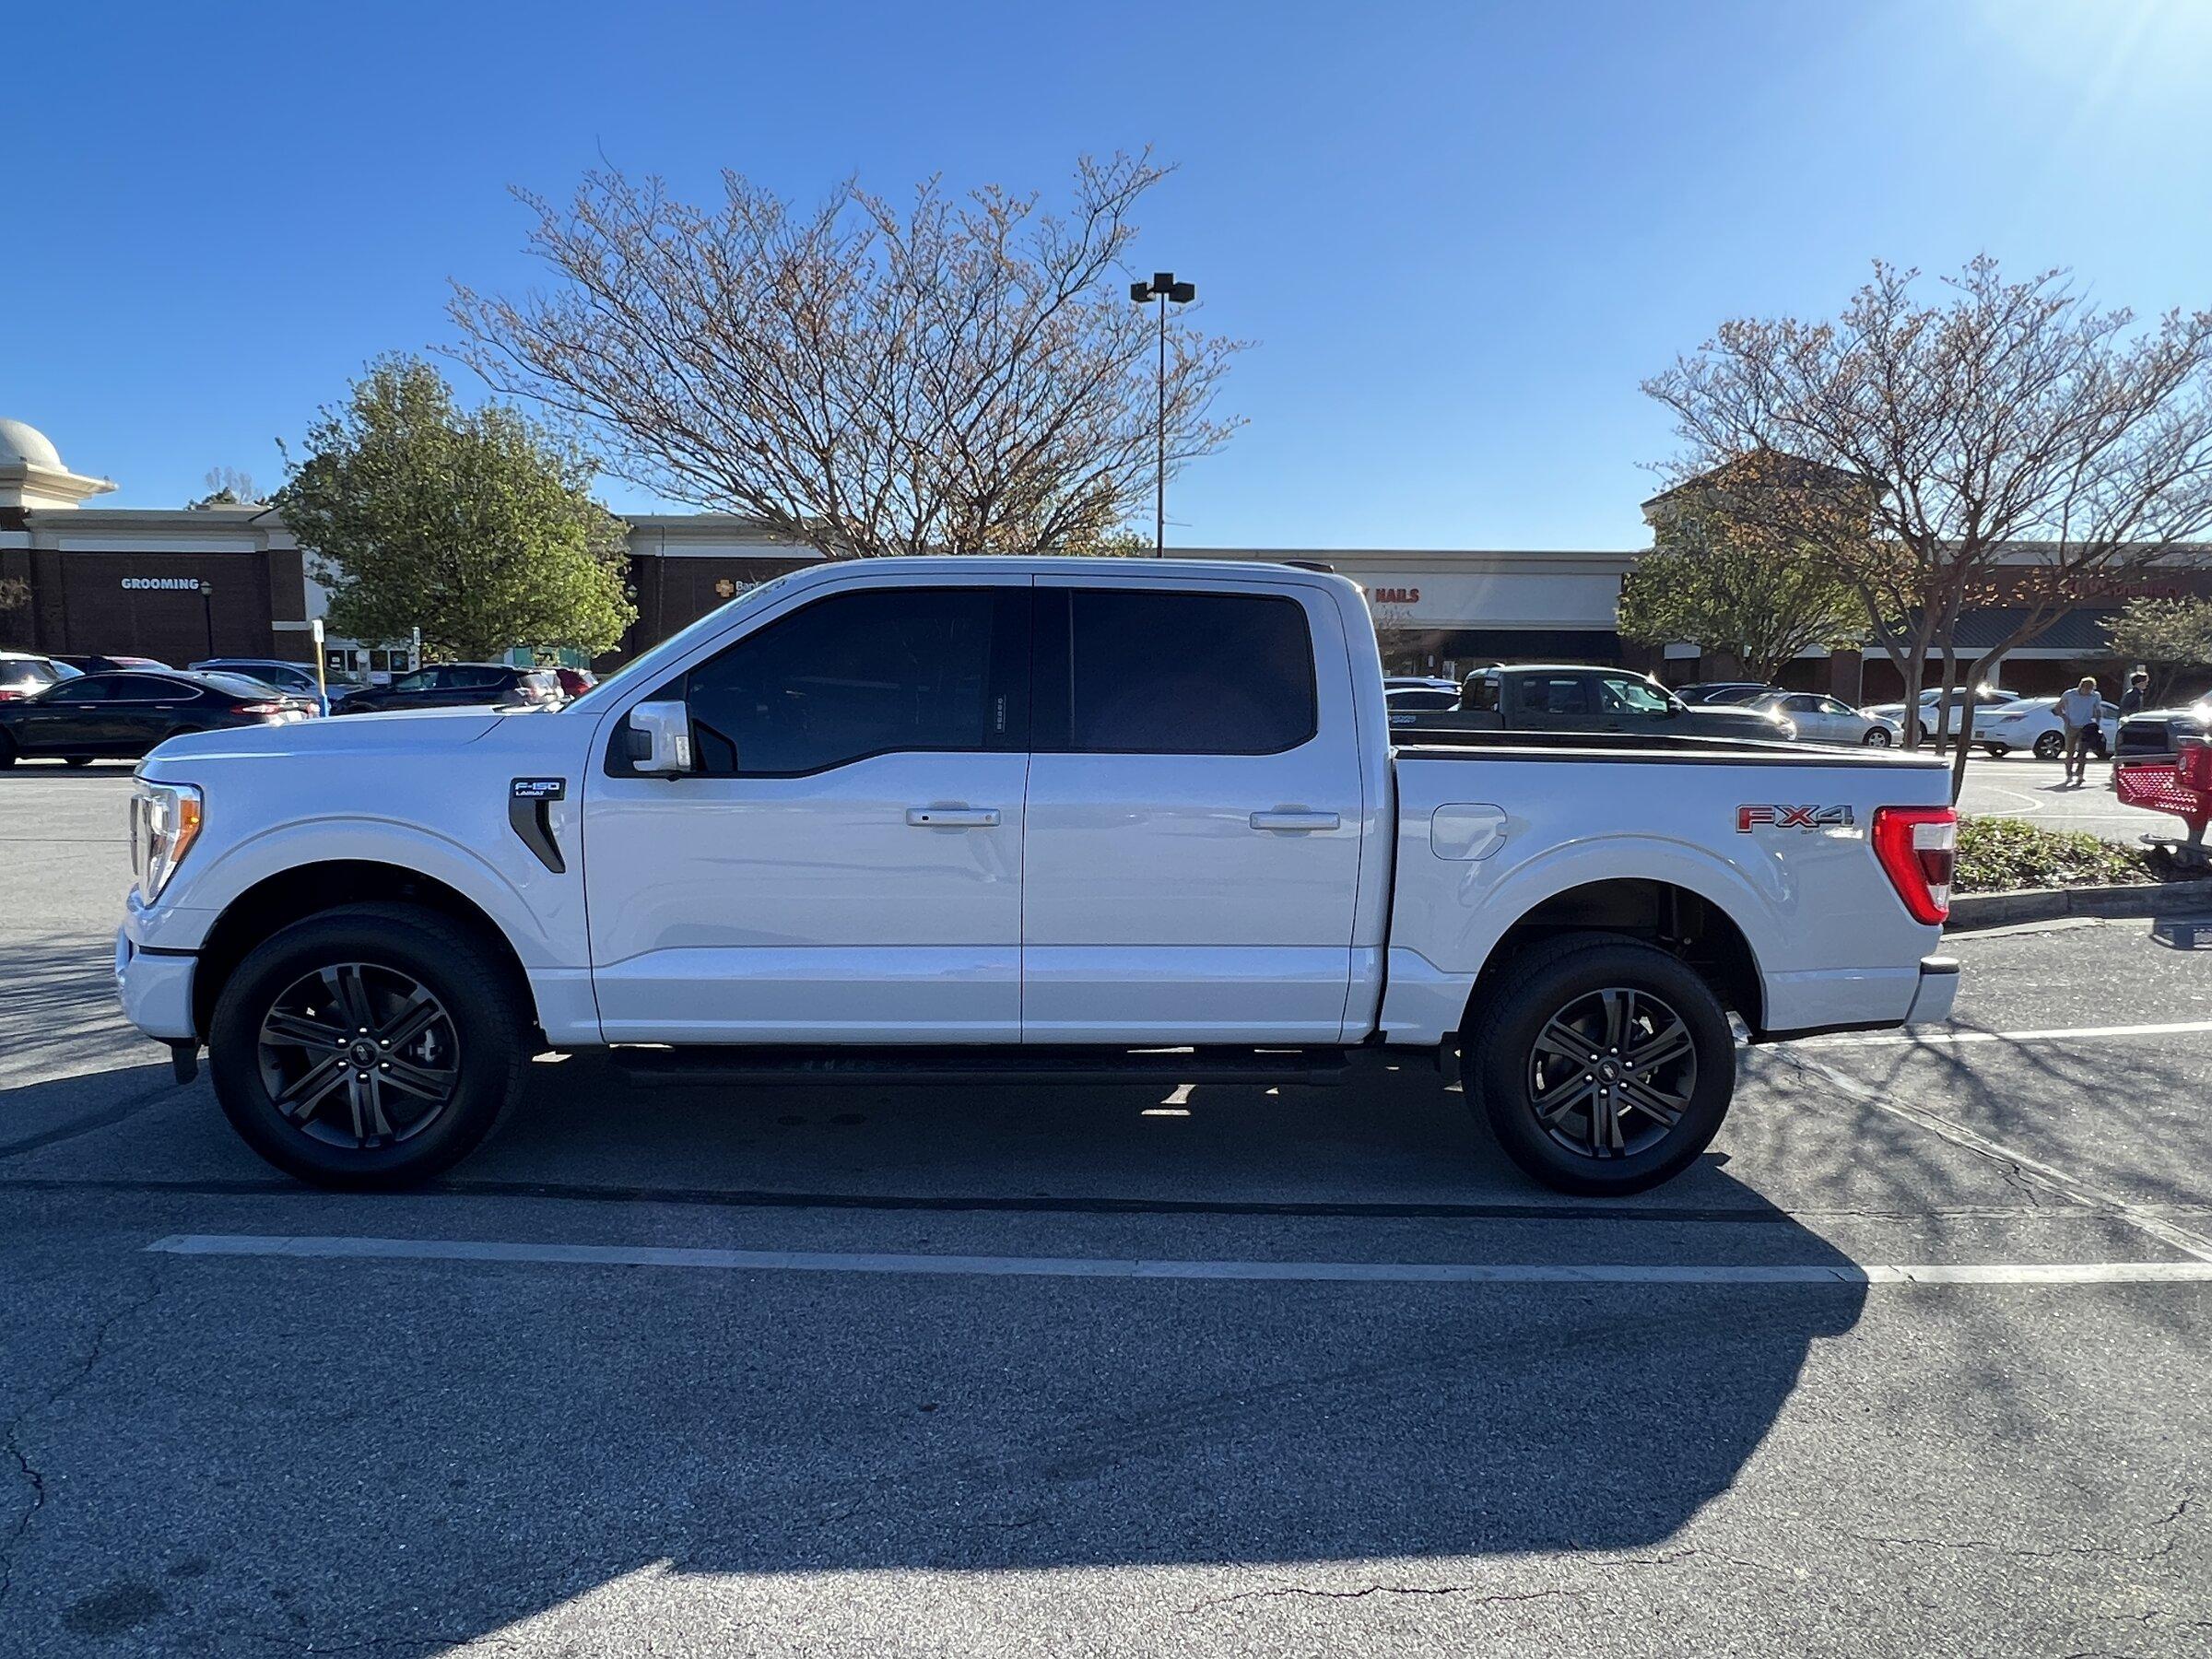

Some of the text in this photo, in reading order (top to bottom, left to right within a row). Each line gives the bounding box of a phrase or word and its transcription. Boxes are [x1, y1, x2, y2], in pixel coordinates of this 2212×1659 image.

[121, 578, 199, 590] GROOMING
[1376, 588, 1419, 603] NAILS
[514, 782, 559, 790] F-150
[1735, 804, 1854, 833] FX4
